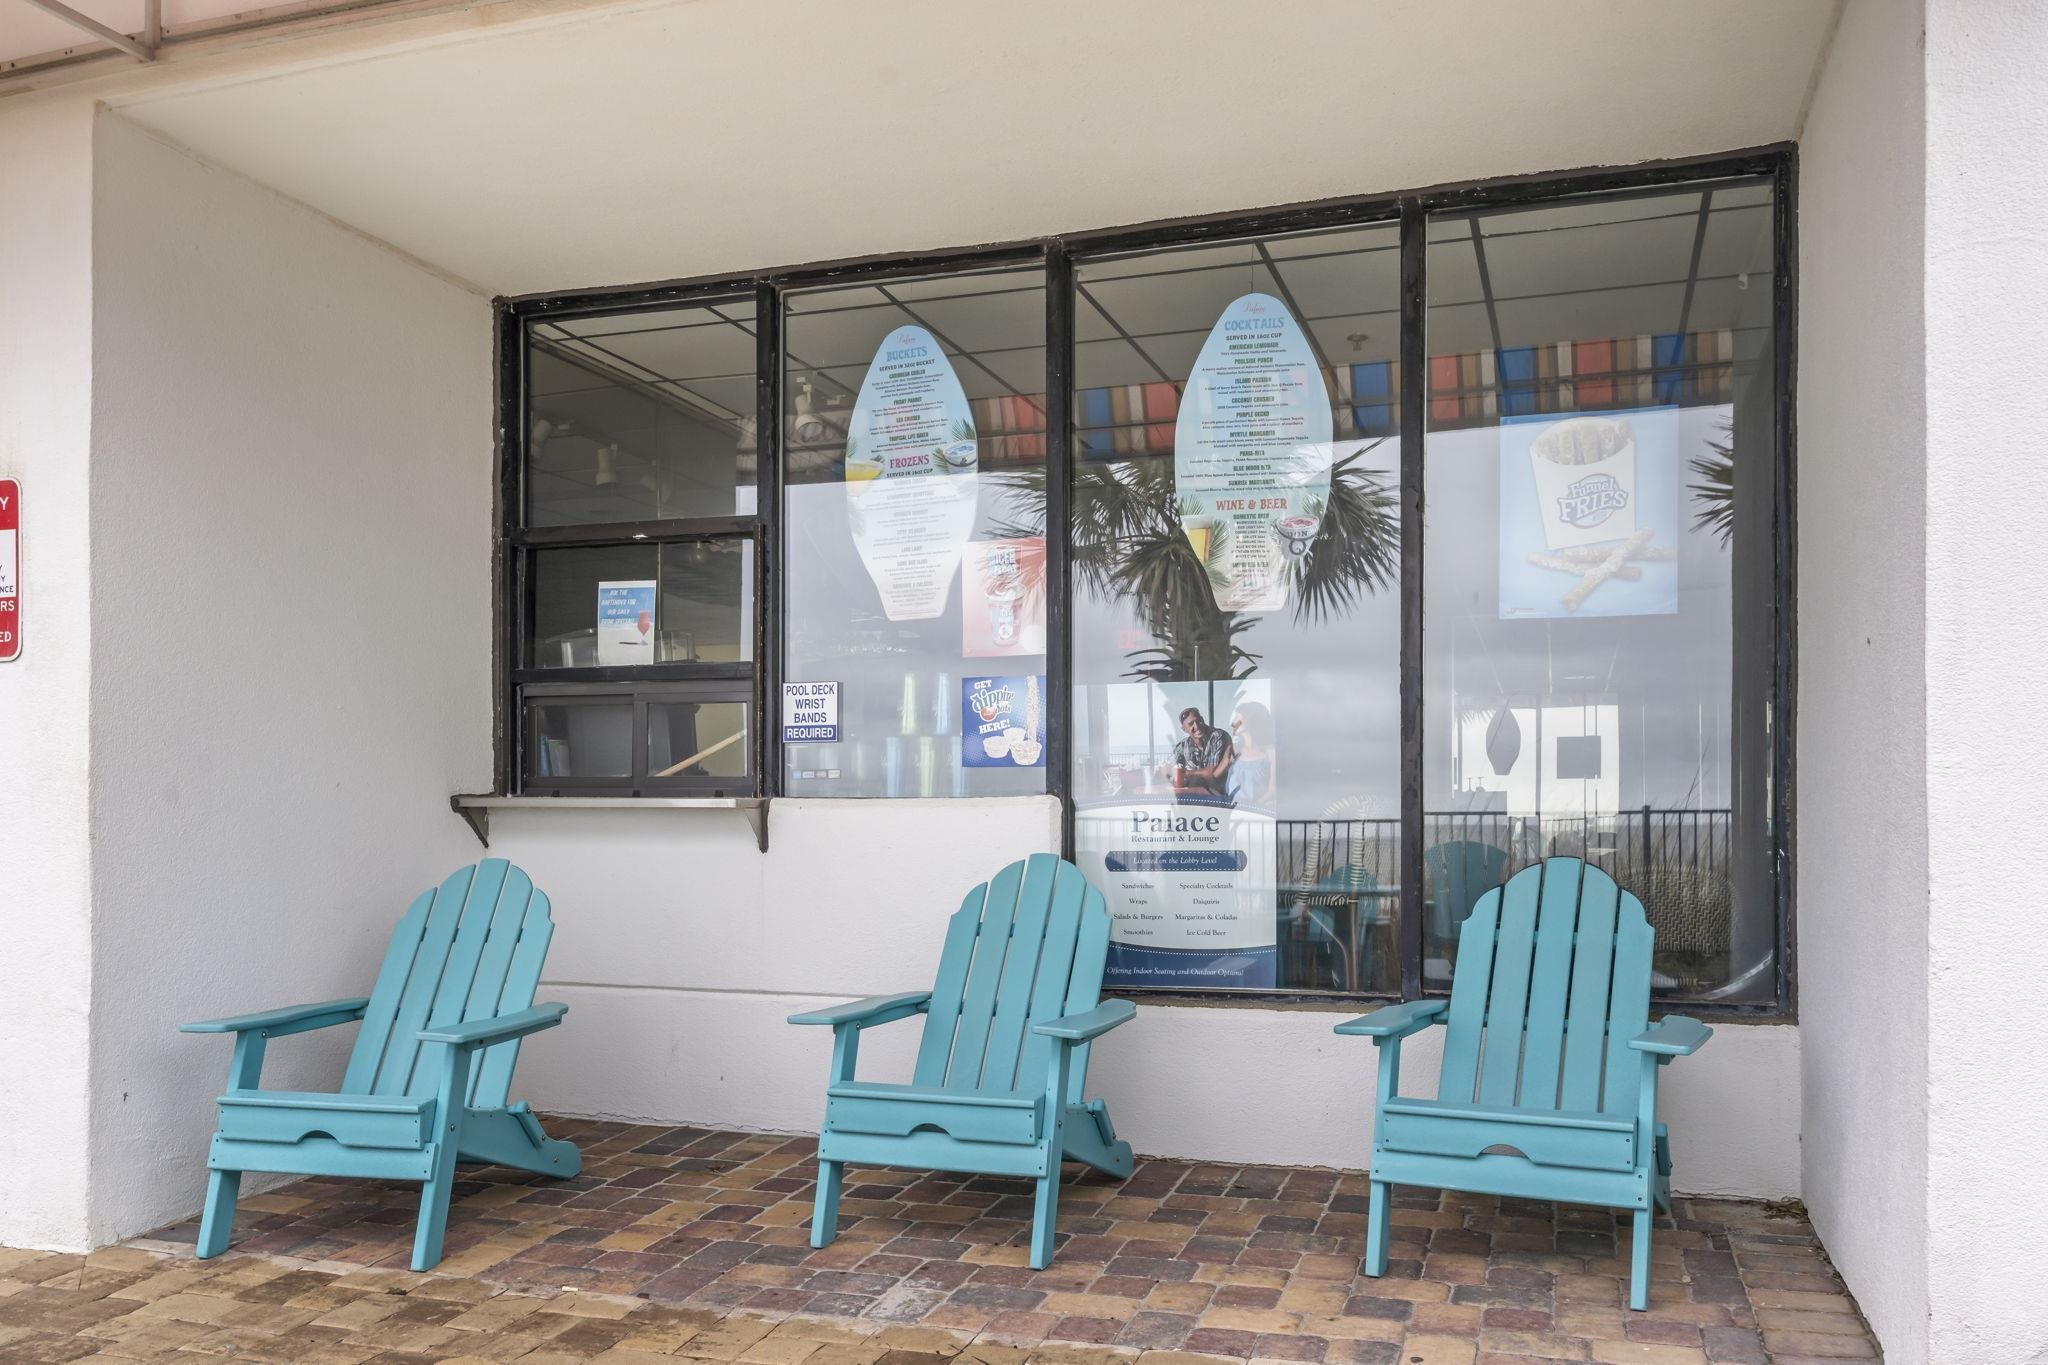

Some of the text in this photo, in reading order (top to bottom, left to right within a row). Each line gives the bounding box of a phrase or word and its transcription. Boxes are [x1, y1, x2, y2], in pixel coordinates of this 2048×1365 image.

[1224, 317, 1285, 331] COCKTAILS
[886, 346, 928, 362] BUCKETS
[879, 364, 897, 373] SERVED
[915, 359, 936, 367] BUCKET
[890, 454, 929, 469] FROZENS
[1568, 478, 1615, 498] Funnel
[1215, 497, 1288, 511] WINE & BEER
[1559, 491, 1627, 521] FRIES
[786, 684, 835, 696] POOL DECK
[974, 680, 992, 690] GET
[795, 698, 827, 709] WRIST
[794, 712, 827, 723] BANDS
[979, 719, 1011, 735] HERE!
[786, 727, 834, 739] REQUIRED
[1131, 810, 1220, 833] Palace
[1131, 835, 1176, 843] Restaurant
[1188, 835, 1220, 845] Lounge
[1133, 856, 1158, 864] Located
[1168, 856, 1180, 864] the
[1180, 856, 1200, 866] Lobby
[1201, 856, 1218, 864] Level
[1179, 882, 1205, 891] Specialty
[1128, 898, 1148, 906] Wraps
[1192, 898, 1220, 906] Daiquiris
[1140, 914, 1164, 922] Burgers
[1175, 913, 1206, 921] Margaritas
[1106, 966, 1132, 976] Offering
[1133, 967, 1152, 975] Indoor
[1153, 967, 1176, 976] Seating
[1177, 968, 1189, 976] and
[1190, 968, 1217, 976] Outdoor
